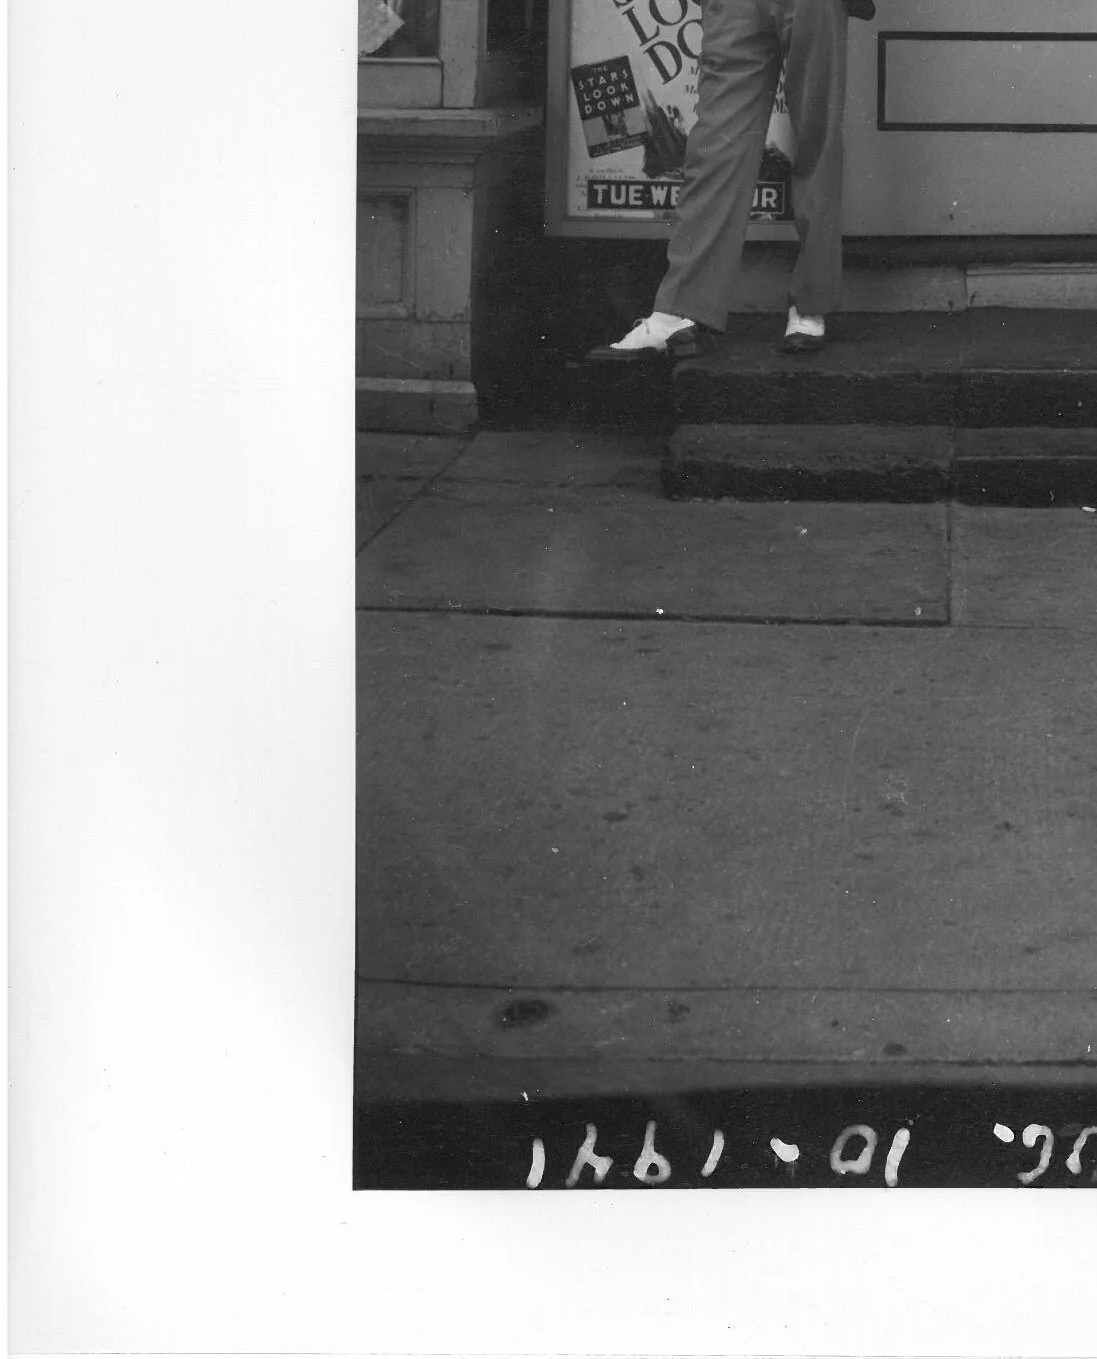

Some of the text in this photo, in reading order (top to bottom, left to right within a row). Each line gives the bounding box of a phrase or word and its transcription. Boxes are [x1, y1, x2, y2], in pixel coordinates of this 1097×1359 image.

[578, 69, 629, 91] STARS
[583, 82, 630, 102] LOOK
[584, 92, 635, 115] DOWN
[592, 183, 643, 206] TUE
